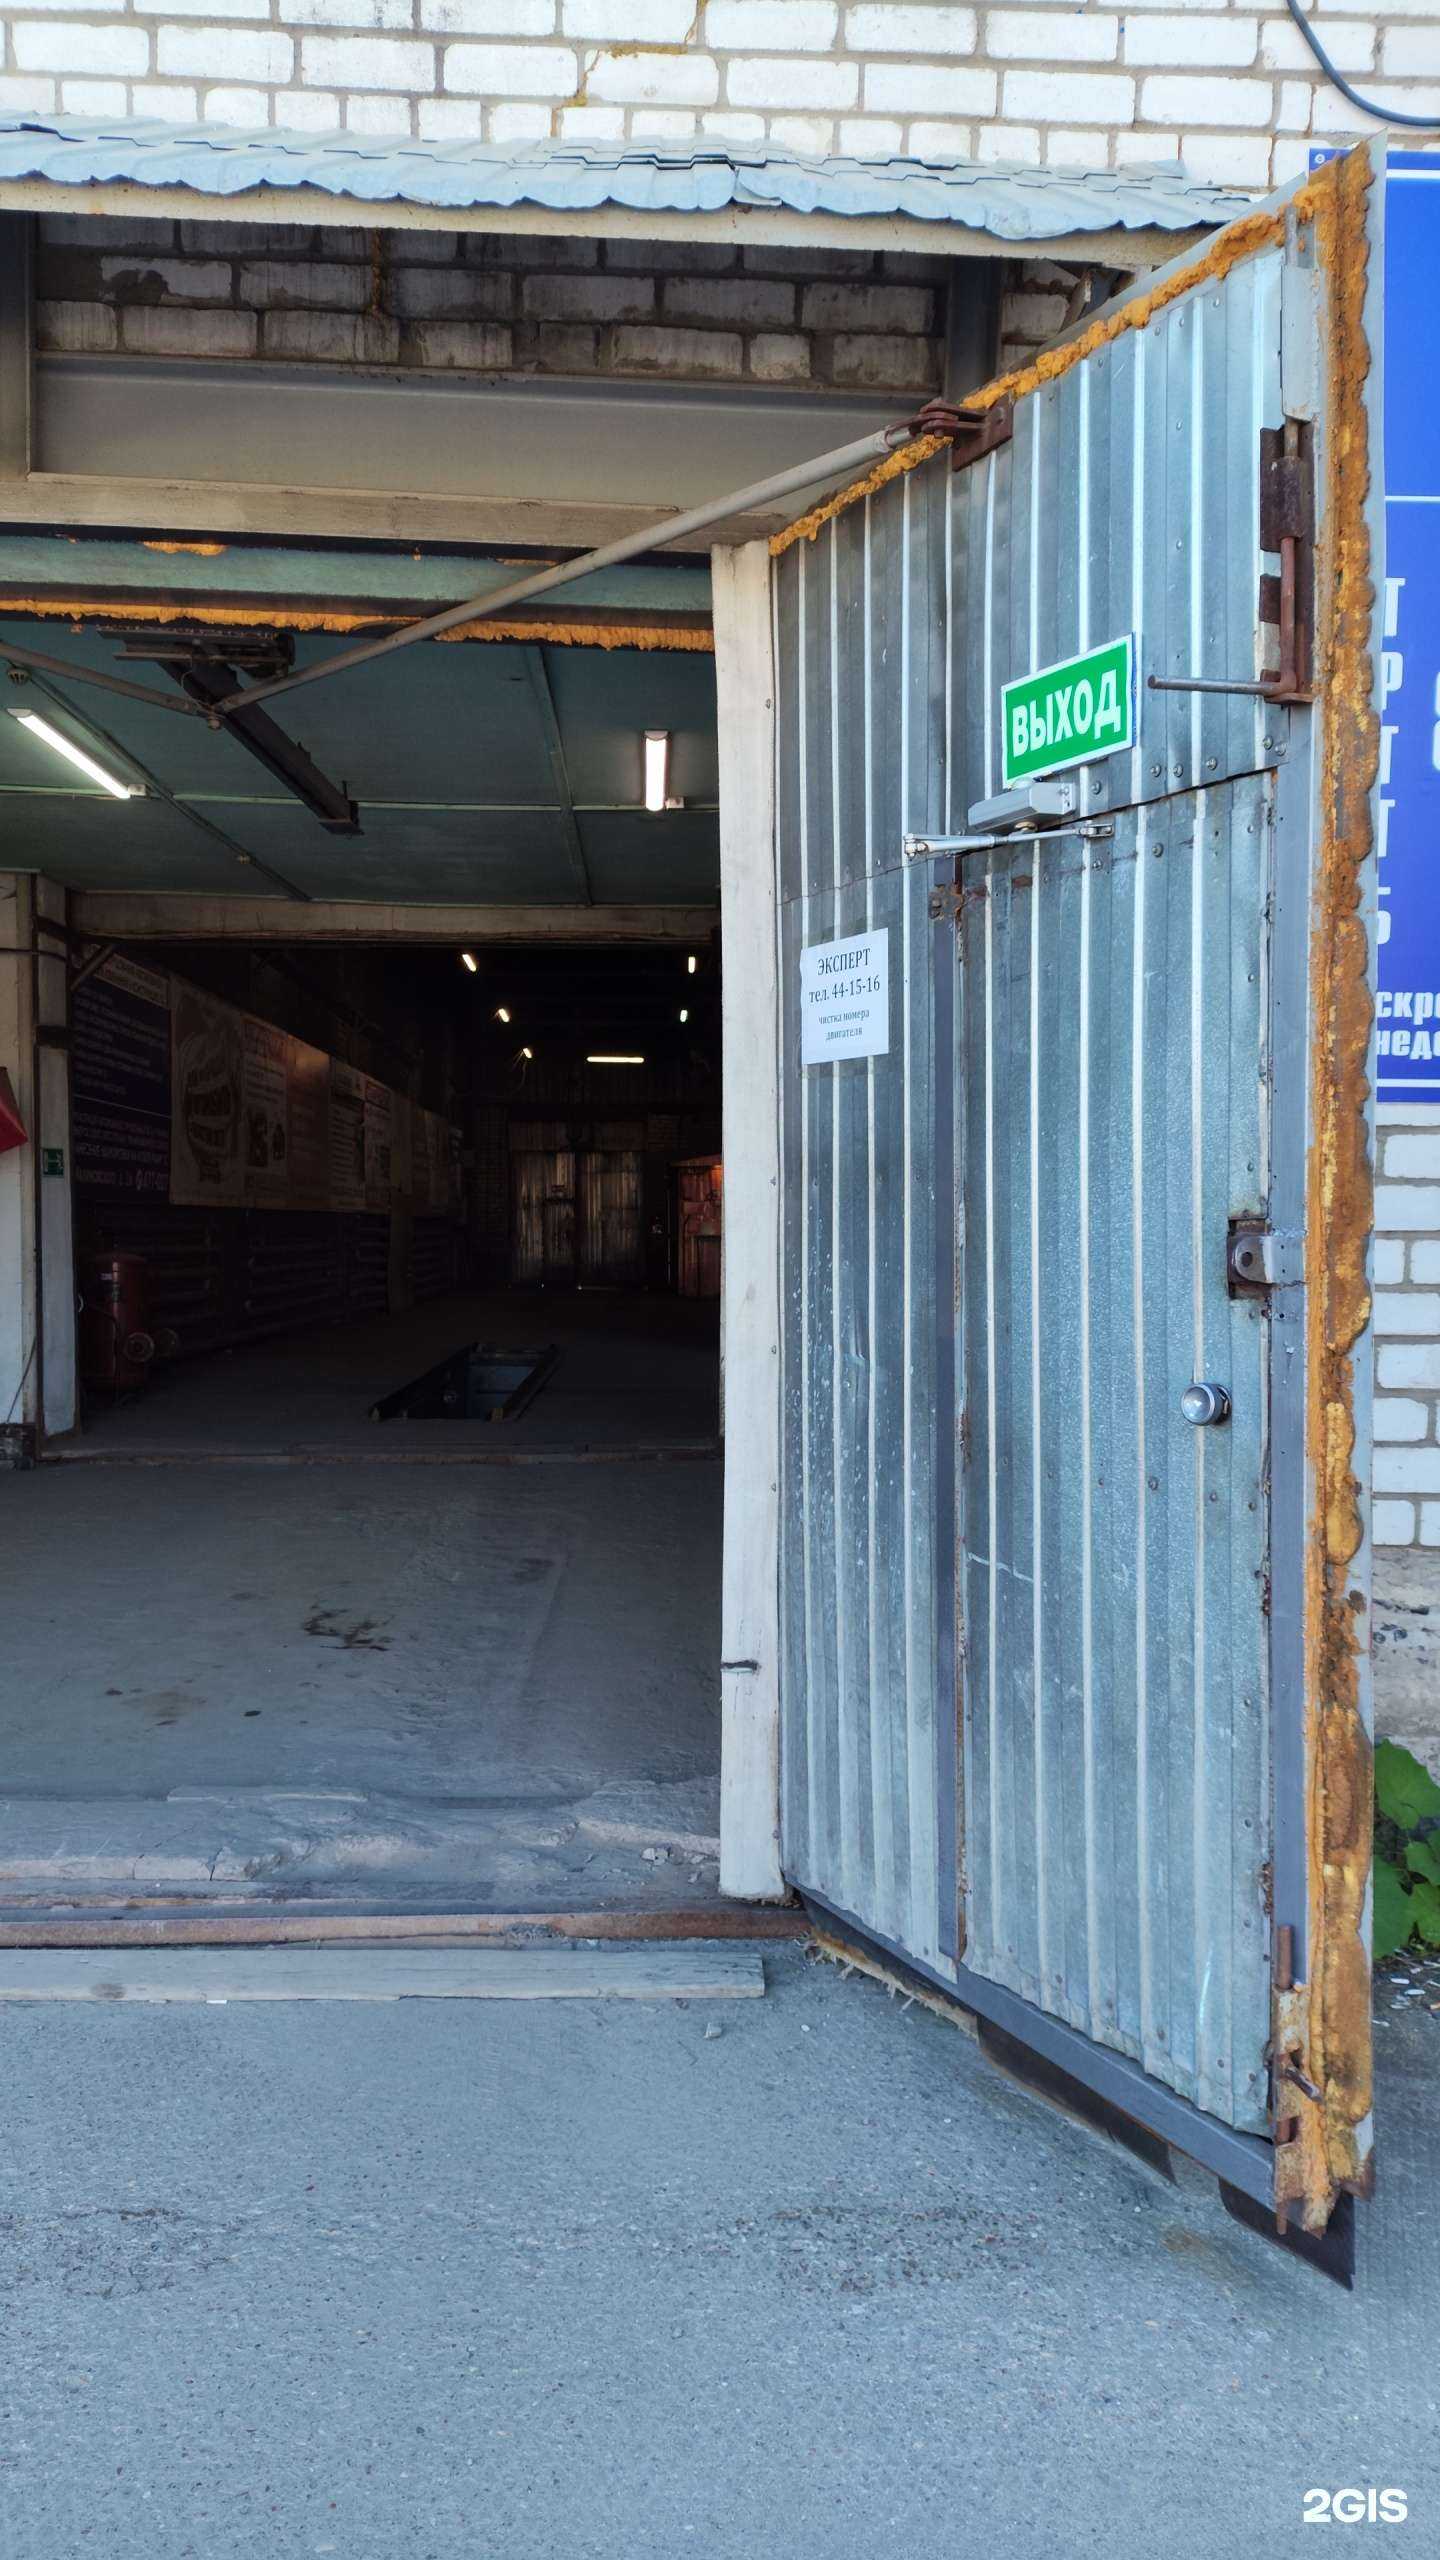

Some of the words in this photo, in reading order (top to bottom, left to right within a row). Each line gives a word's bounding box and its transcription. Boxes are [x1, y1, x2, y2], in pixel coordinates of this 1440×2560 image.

[1012, 668, 1121, 758] ВЫХОД
[817, 948, 871, 976] ЭКСПЕРТ
[808, 989, 830, 1003] тел.
[832, 975, 880, 999] 44-15-16
[818, 1012, 842, 1025] чистка
[843, 1008, 870, 1022] номера
[825, 1027, 863, 1041] двигателя
